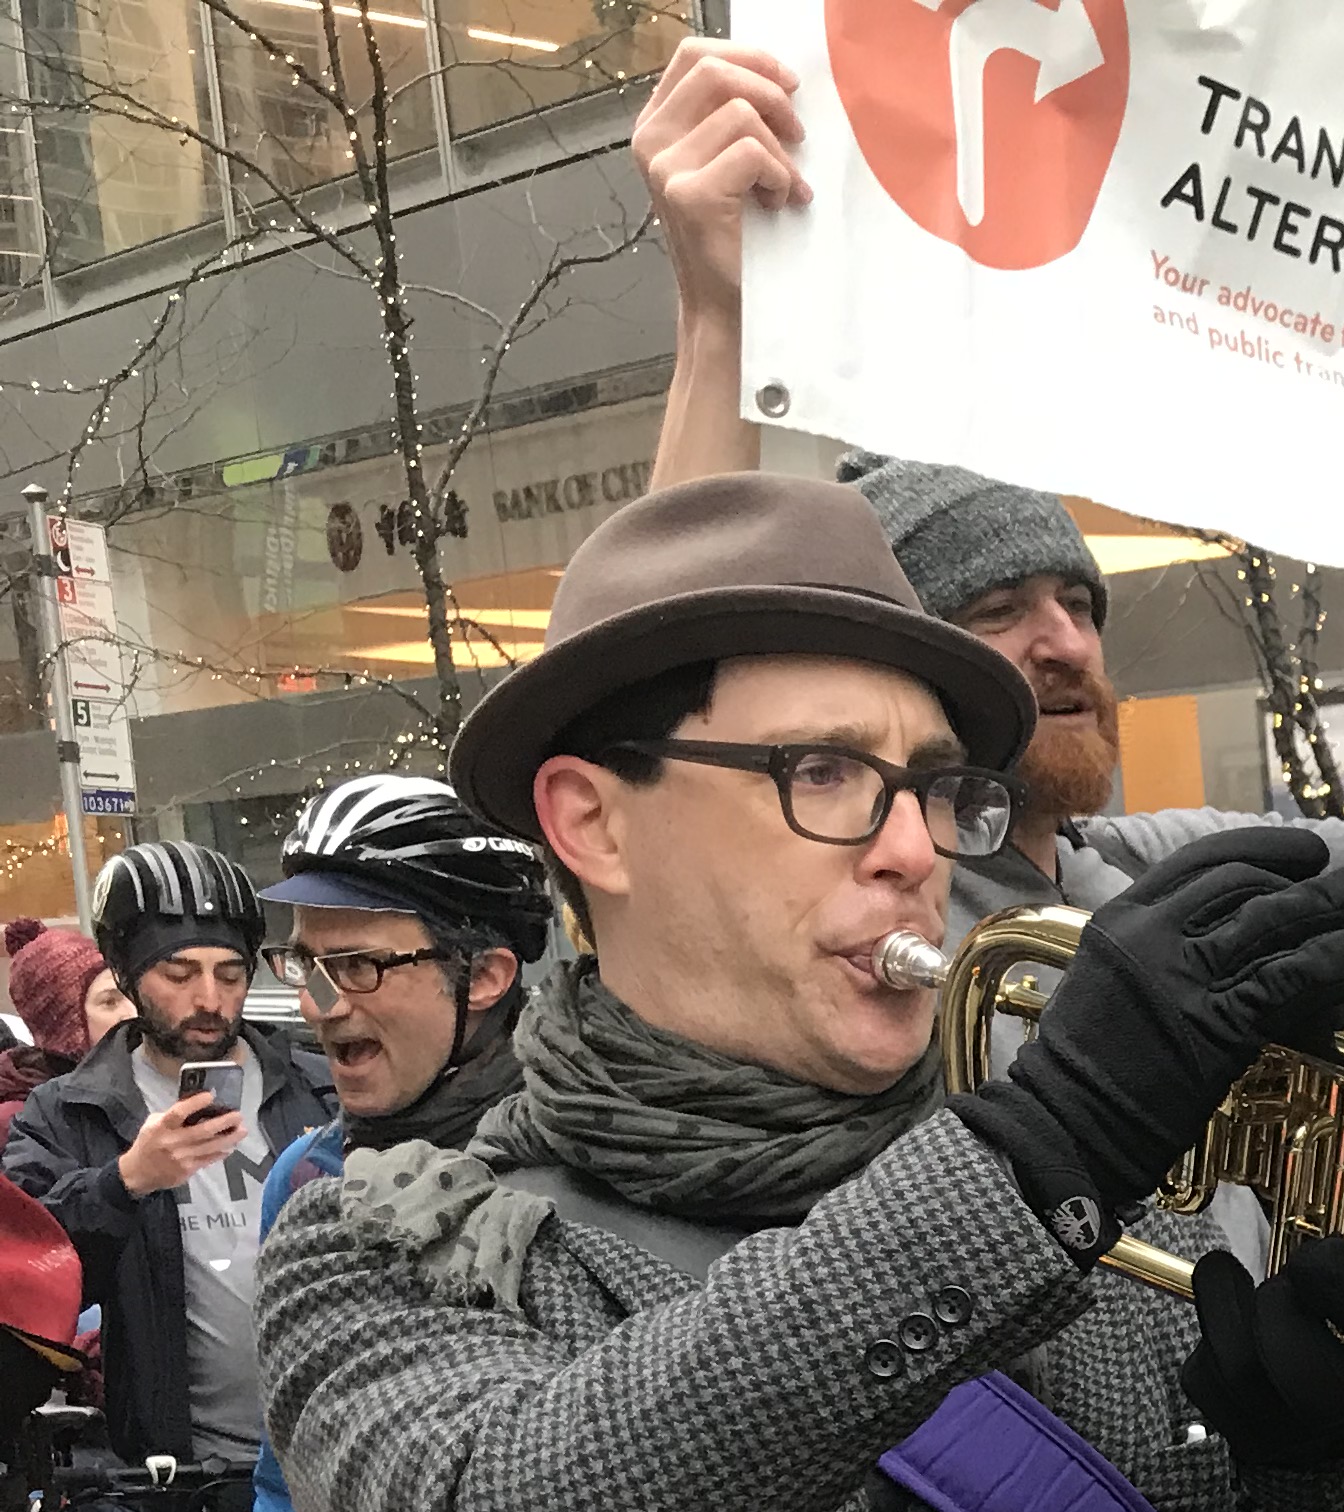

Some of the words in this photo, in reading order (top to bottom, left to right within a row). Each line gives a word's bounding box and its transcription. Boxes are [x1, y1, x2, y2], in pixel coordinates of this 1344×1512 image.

[1150, 249, 1209, 296] Your
[1217, 284, 1335, 343] advocate
[1152, 304, 1199, 336] and
[1207, 326, 1285, 369] public
[492, 479, 564, 522] BANK
[61, 580, 73, 601] 3
[76, 701, 88, 725] 5
